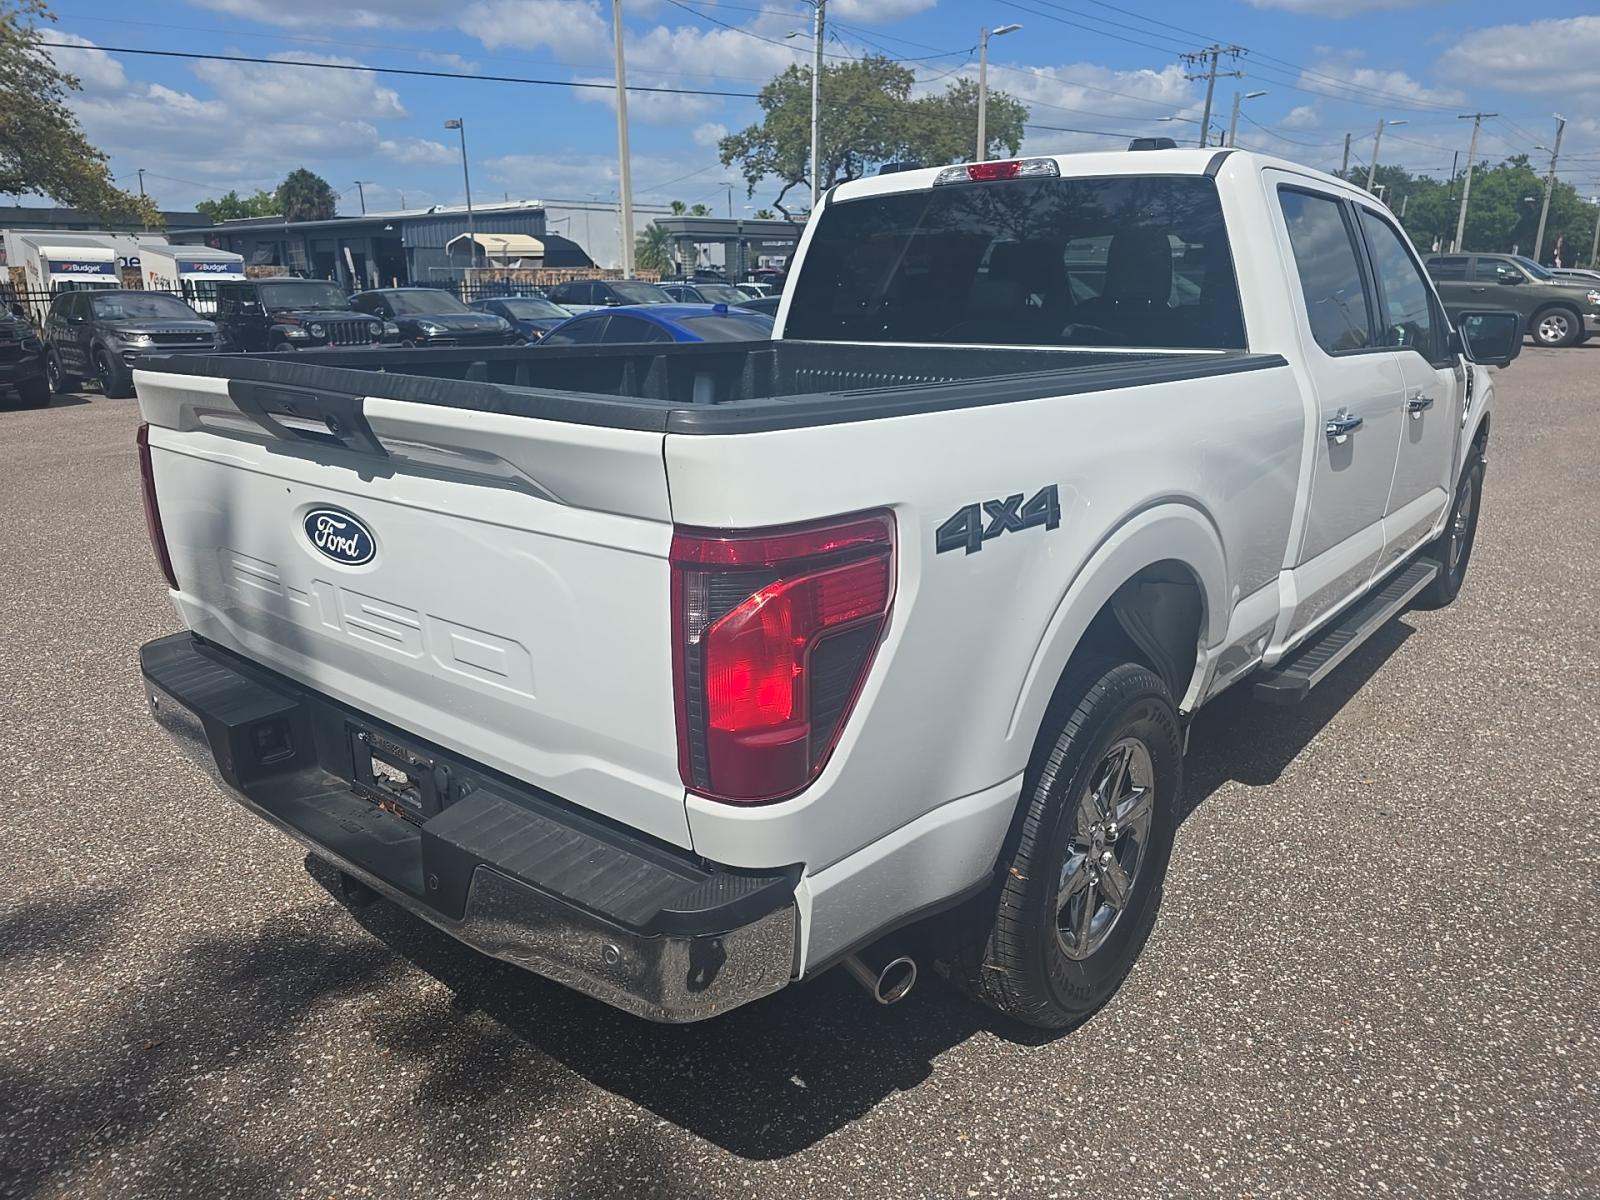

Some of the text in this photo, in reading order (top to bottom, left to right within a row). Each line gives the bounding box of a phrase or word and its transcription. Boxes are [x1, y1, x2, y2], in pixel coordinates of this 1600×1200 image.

[72, 264, 101, 273] Budget
[203, 264, 228, 272] Budget
[314, 516, 360, 558] Ford
[218, 546, 537, 700] F-150
